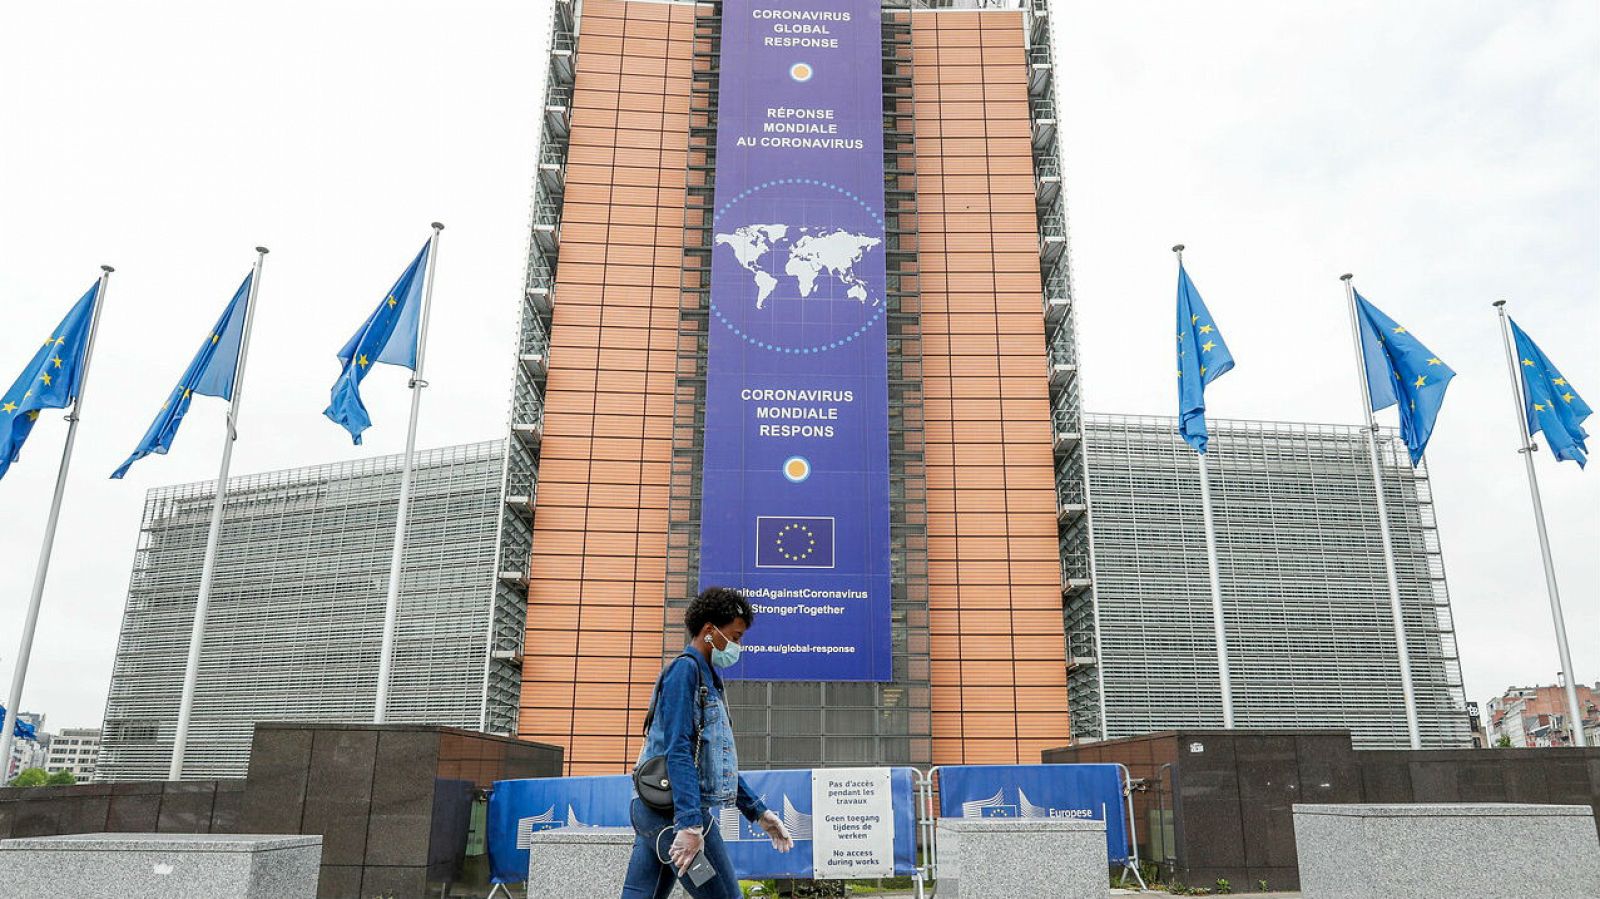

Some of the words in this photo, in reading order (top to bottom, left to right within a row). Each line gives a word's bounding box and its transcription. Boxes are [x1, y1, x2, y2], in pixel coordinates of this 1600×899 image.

[752, 9, 851, 21] CORONAVIRUS
[773, 24, 830, 34] GLOBAL
[764, 37, 838, 48] RESPONSE
[767, 107, 834, 119] RÉPONSE
[763, 123, 837, 134] MONDIALE
[737, 137, 756, 147] AU
[760, 138, 864, 149] CORONAVIRUS
[741, 389, 853, 402] CORONAVIRUS
[756, 407, 838, 419] MONDIALE
[760, 425, 834, 437] RESPONS
[723, 588, 868, 600] nitedAgainstCoronavirus
[749, 604, 845, 616] StrongerTogether
[740, 644, 855, 654] uropa.eu/global-response
[1050, 808, 1092, 818] Europese
